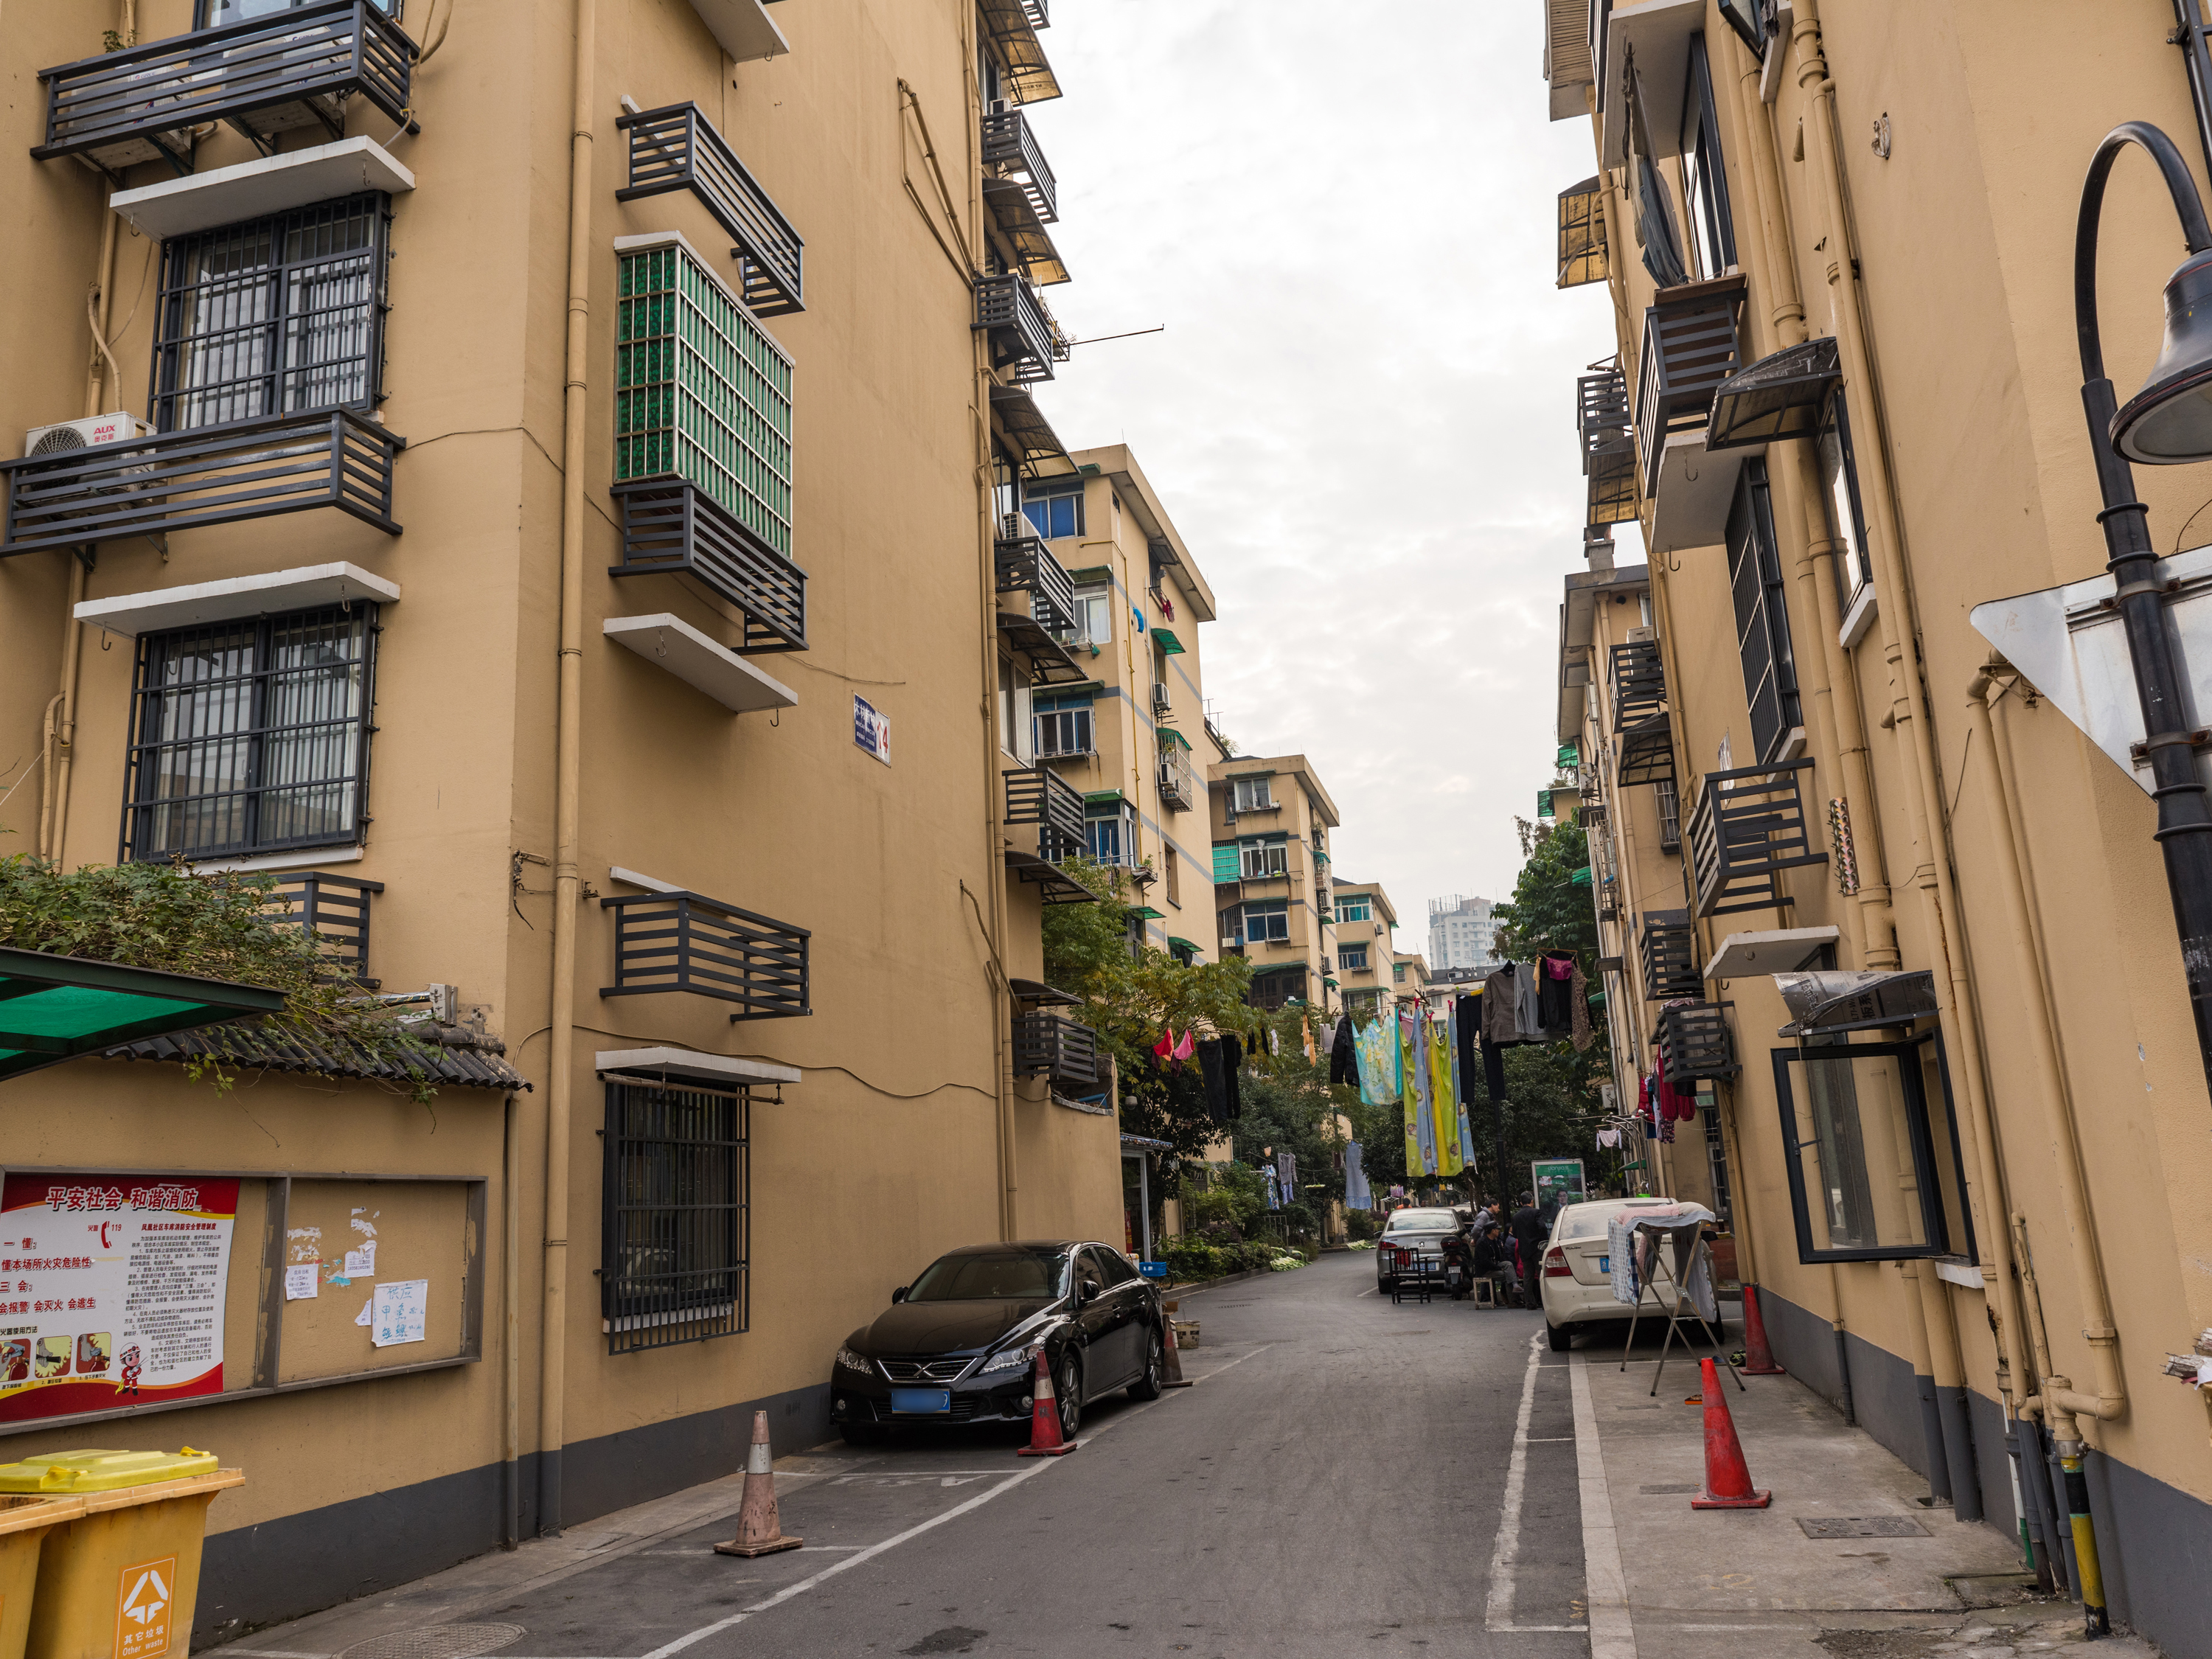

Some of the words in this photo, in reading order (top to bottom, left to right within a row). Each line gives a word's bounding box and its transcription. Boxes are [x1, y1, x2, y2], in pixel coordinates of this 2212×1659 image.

[93, 424, 116, 435] AUX
[94, 433, 115, 443] 奥克斯
[877, 721, 888, 754] 14
[46, 1187, 123, 1211] 平安社会
[131, 1188, 198, 1211] 和谐消防
[87, 1224, 99, 1232] 火警
[111, 1223, 122, 1231] 119
[141, 1222, 217, 1231] 凤凰社区车库消防安全管理制度
[1, 1256, 91, 1272] 懂本场所火灾危险性
[0, 1281, 10, 1293] 三
[387, 1284, 413, 1300] 供应
[0, 1301, 30, 1315] 会报警
[34, 1299, 63, 1312] 会灭火
[68, 1296, 97, 1311] 会逃生
[124, 1625, 164, 1646] 其它垃圾
[122, 1646, 141, 1657] Other
[145, 1638, 163, 1650] waste
